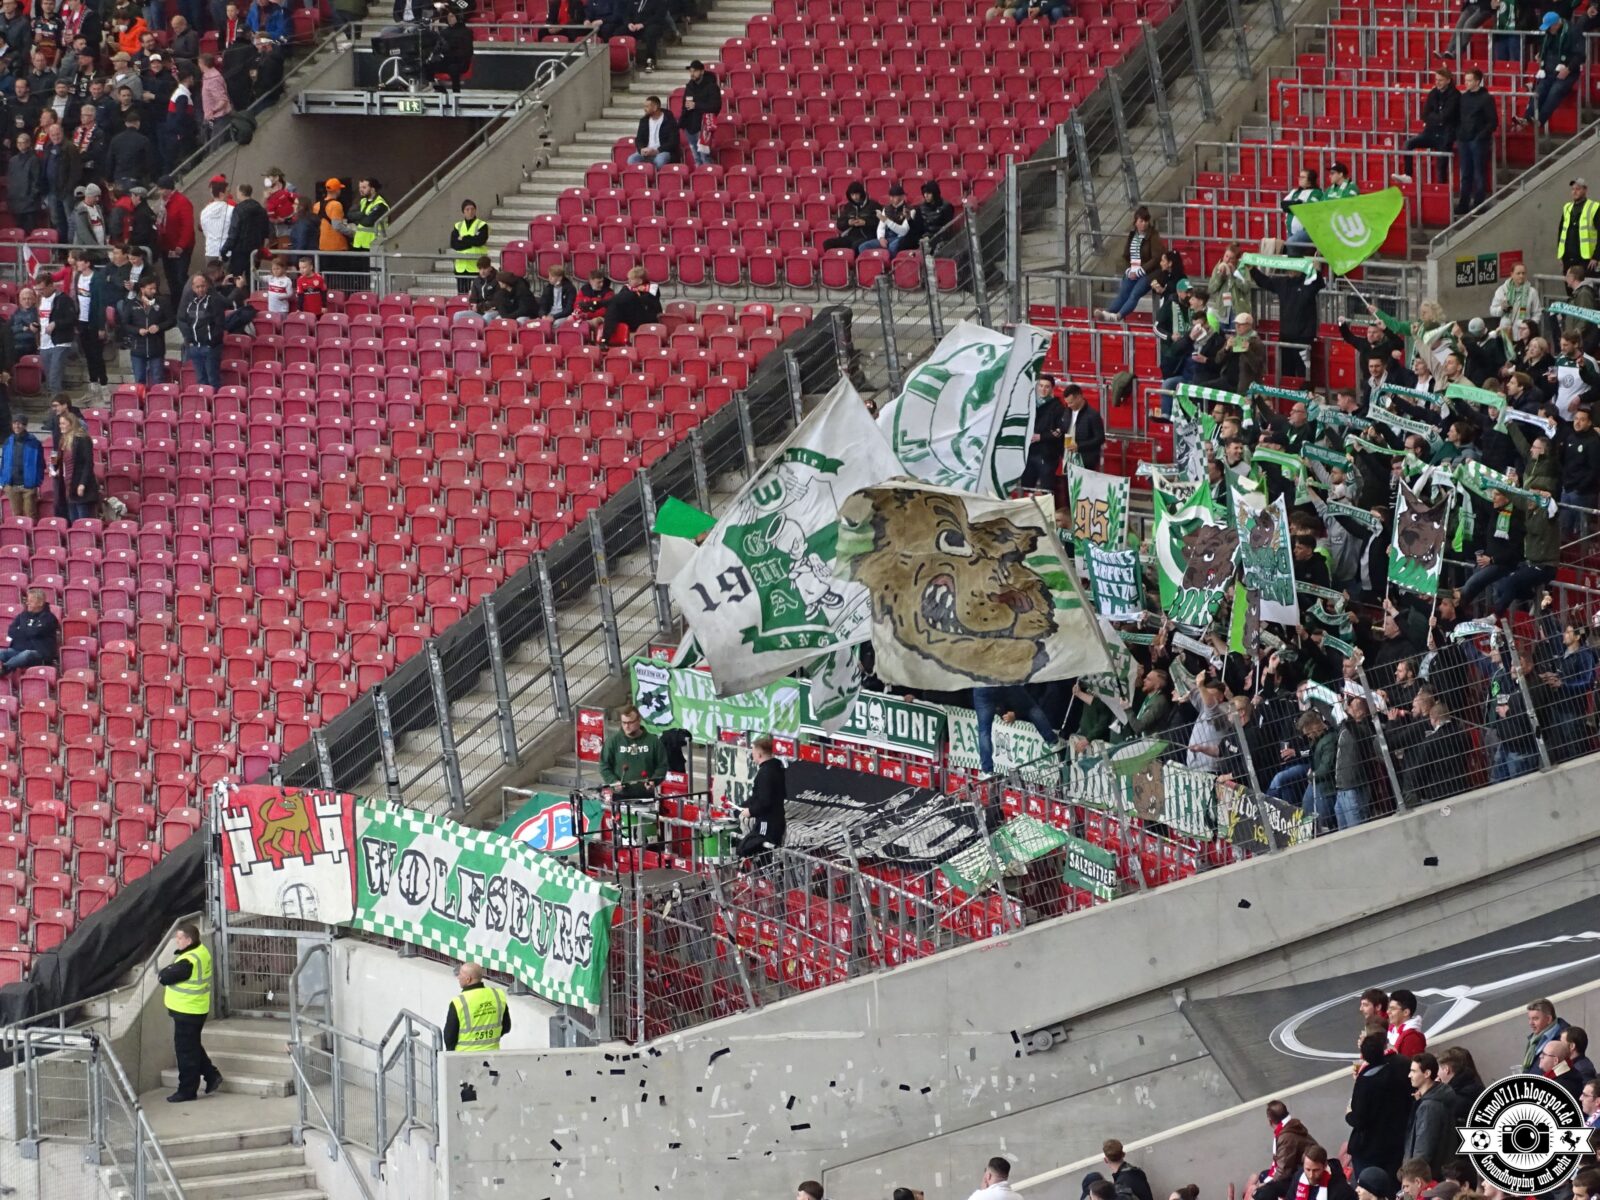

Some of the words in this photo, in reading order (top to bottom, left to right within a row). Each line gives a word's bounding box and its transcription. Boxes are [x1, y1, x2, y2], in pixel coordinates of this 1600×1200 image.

[1074, 497, 1109, 544] 95
[689, 566, 752, 612] 19
[1069, 852, 1117, 887] SALZGITTER
[361, 836, 593, 968] WOLFSBURG
[475, 1029, 494, 1041] 2519
